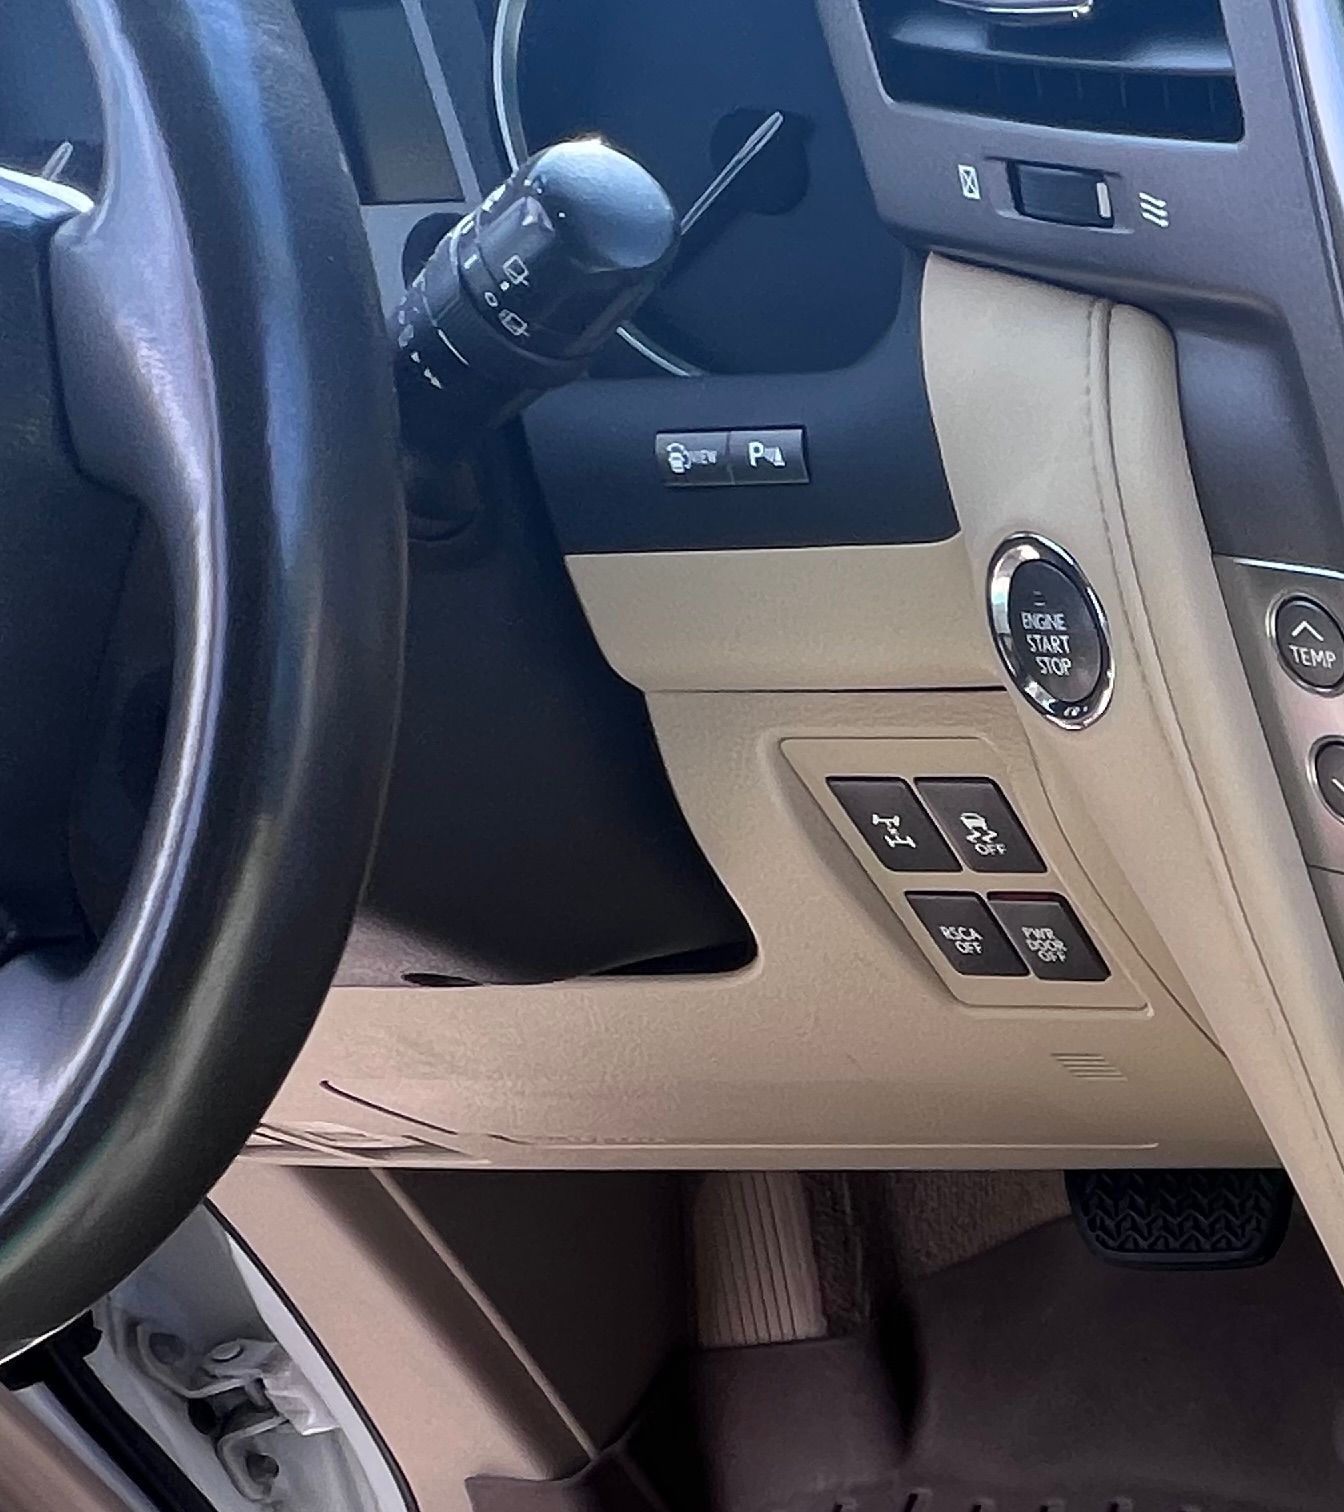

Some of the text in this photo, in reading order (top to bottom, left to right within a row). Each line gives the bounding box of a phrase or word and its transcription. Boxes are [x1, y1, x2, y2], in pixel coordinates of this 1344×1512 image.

[1021, 612, 1067, 630] ENGINE
[1026, 635, 1069, 653] START
[1289, 645, 1336, 668] TEMP
[1036, 657, 1071, 675] STOP
[975, 844, 1007, 856] OFF
[940, 926, 983, 940] RSCA
[1022, 927, 1055, 939] PWR
[955, 941, 982, 954] OFF
[1026, 940, 1066, 952] DOOR
[1039, 951, 1066, 962] OFF
